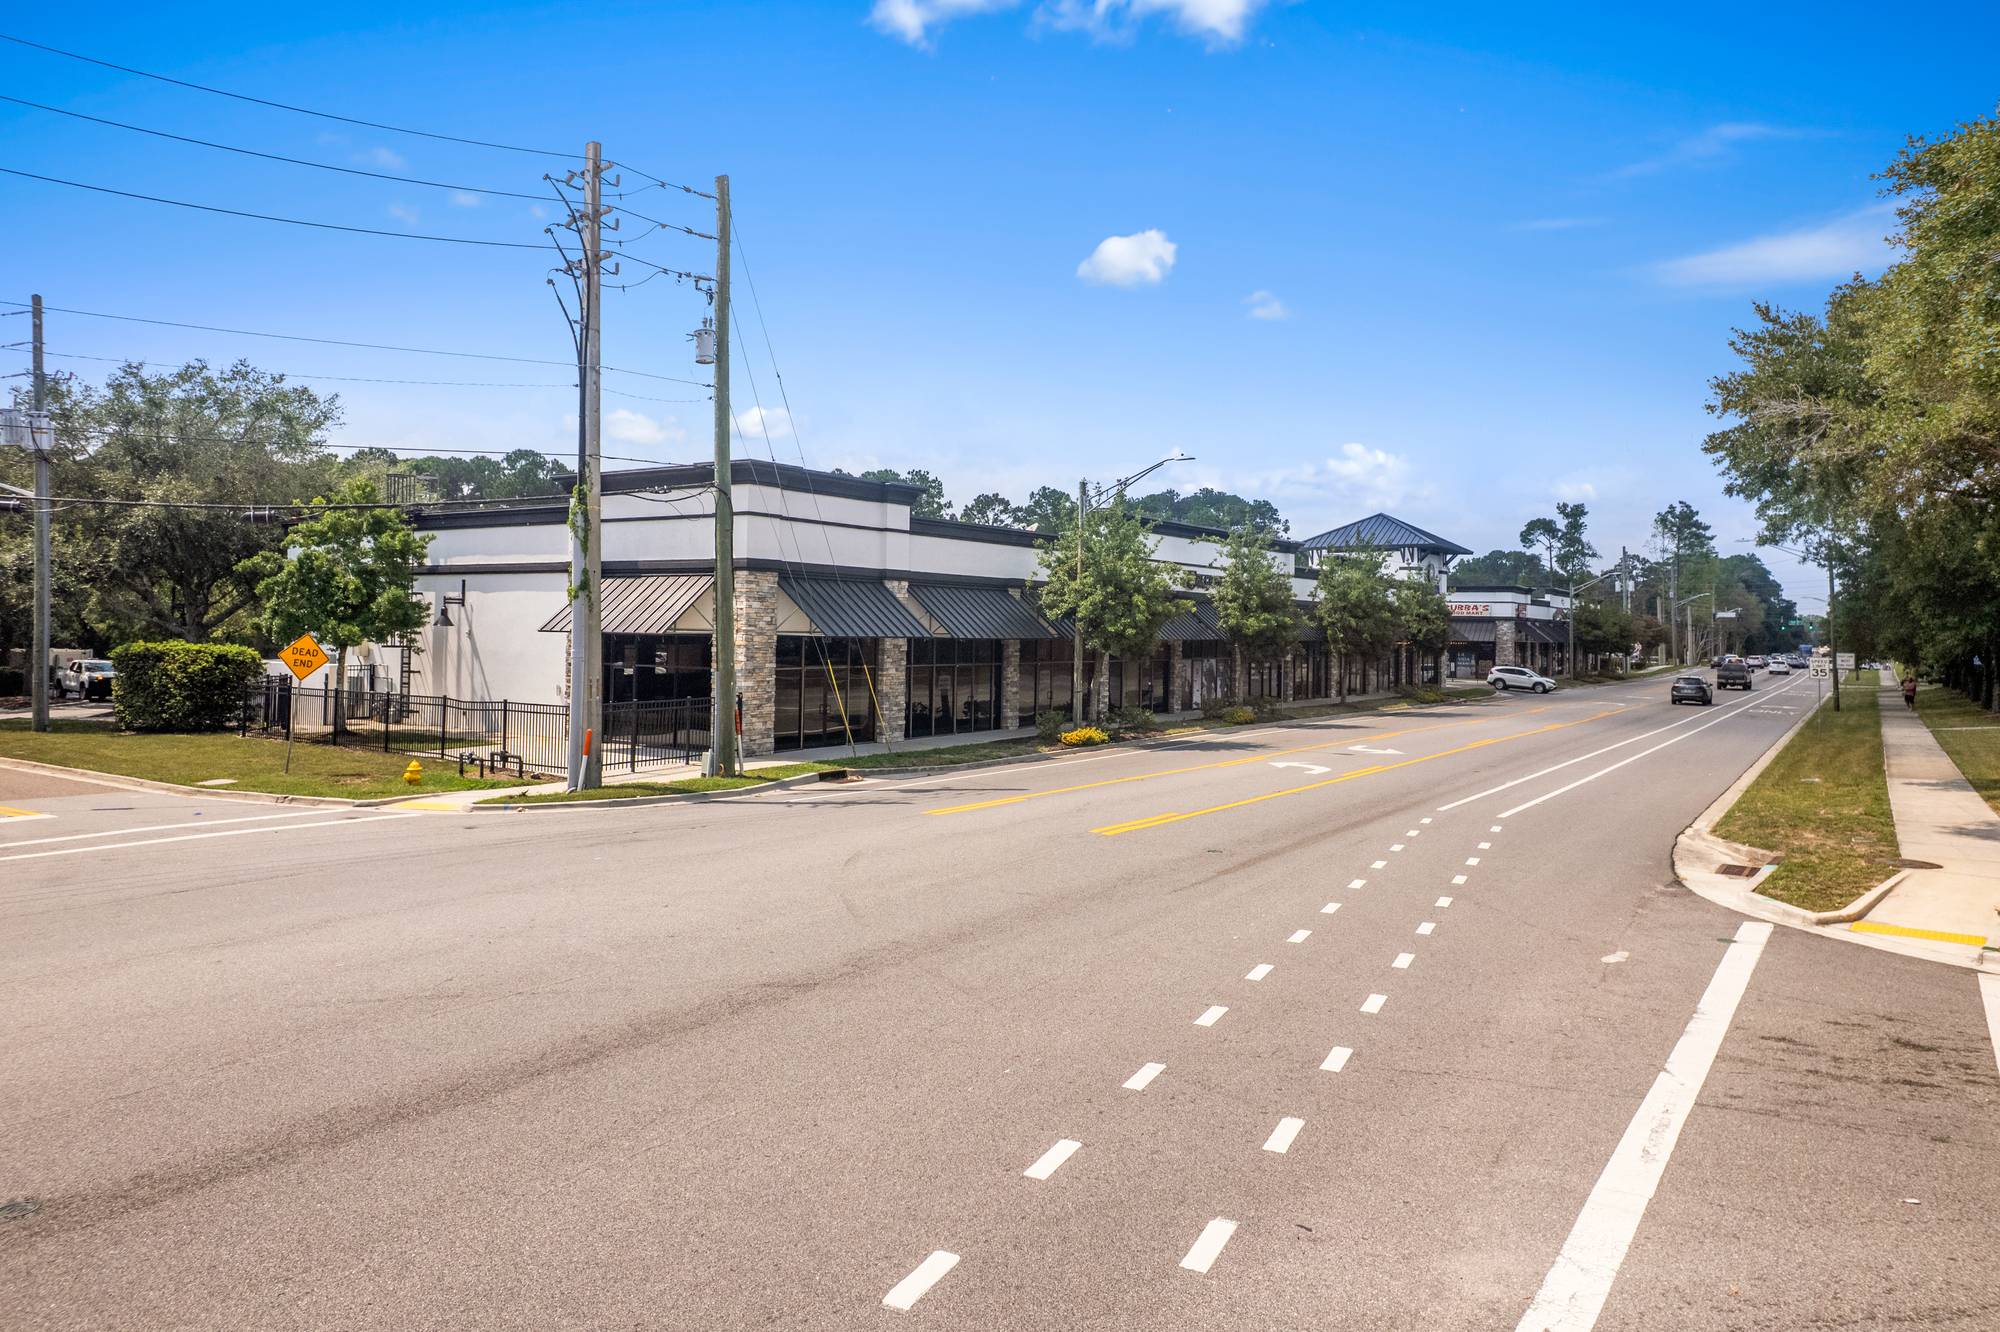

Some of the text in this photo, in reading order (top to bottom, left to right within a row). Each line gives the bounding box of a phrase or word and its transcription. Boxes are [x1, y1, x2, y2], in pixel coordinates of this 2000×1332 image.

[292, 647, 319, 657] DEAD
[293, 659, 313, 668] END
[1812, 669, 1828, 677] 35
